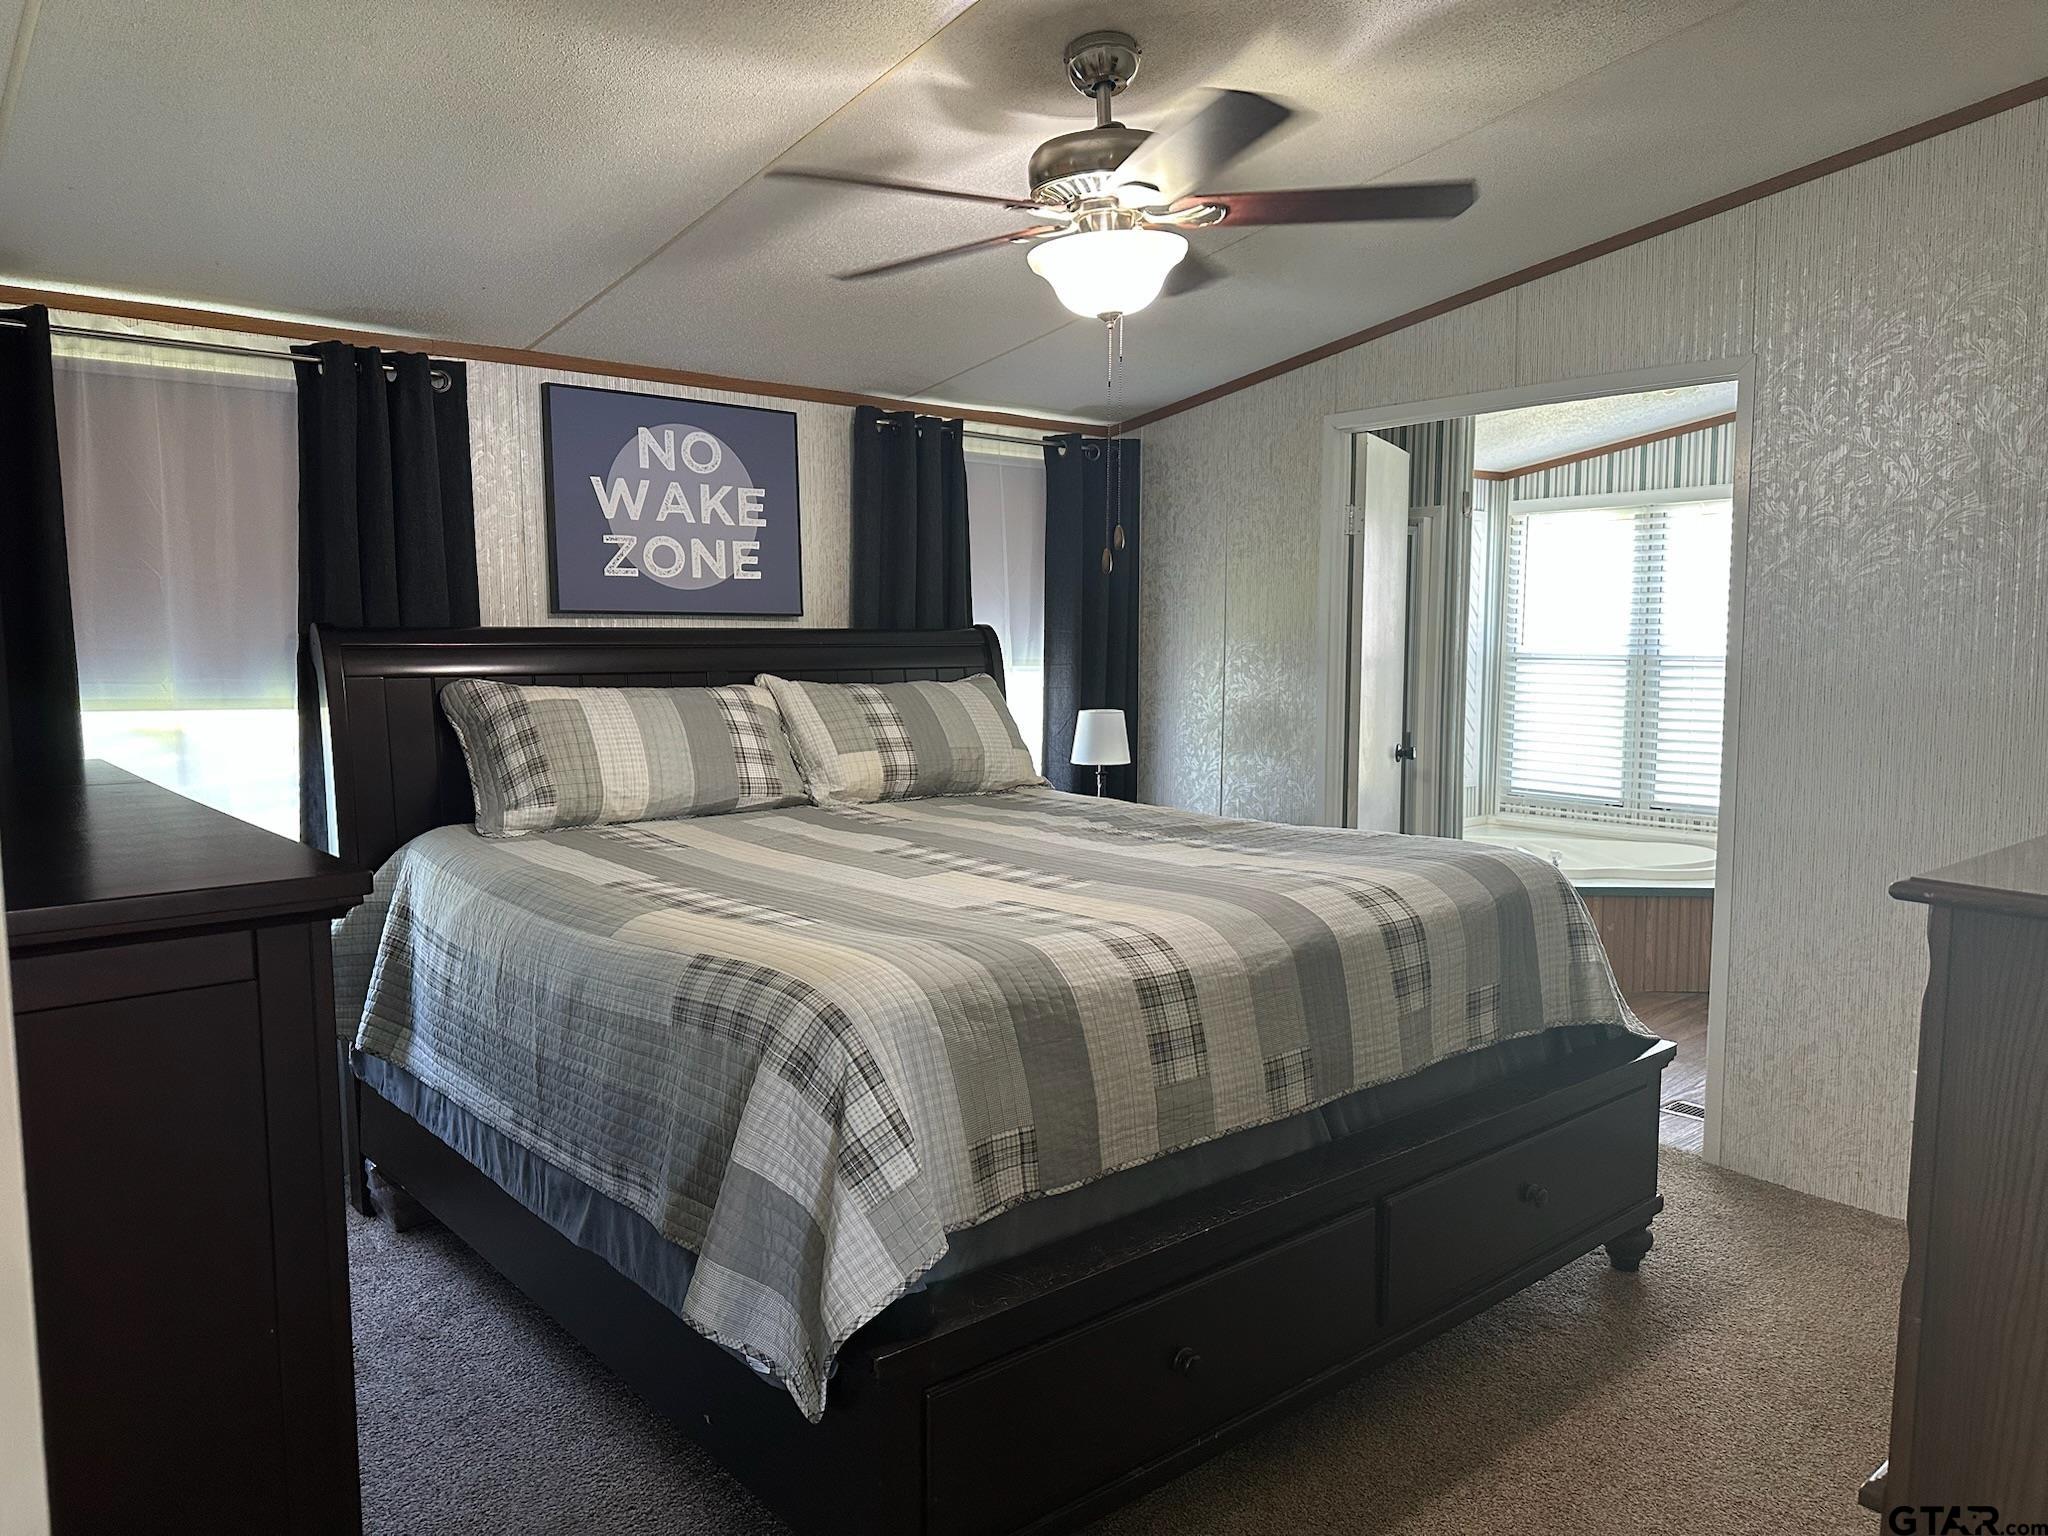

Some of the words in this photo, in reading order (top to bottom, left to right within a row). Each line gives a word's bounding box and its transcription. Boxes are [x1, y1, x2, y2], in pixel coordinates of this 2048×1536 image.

[637, 426, 722, 475] NO
[589, 475, 767, 528] WAKE
[602, 534, 762, 580] ZONE
